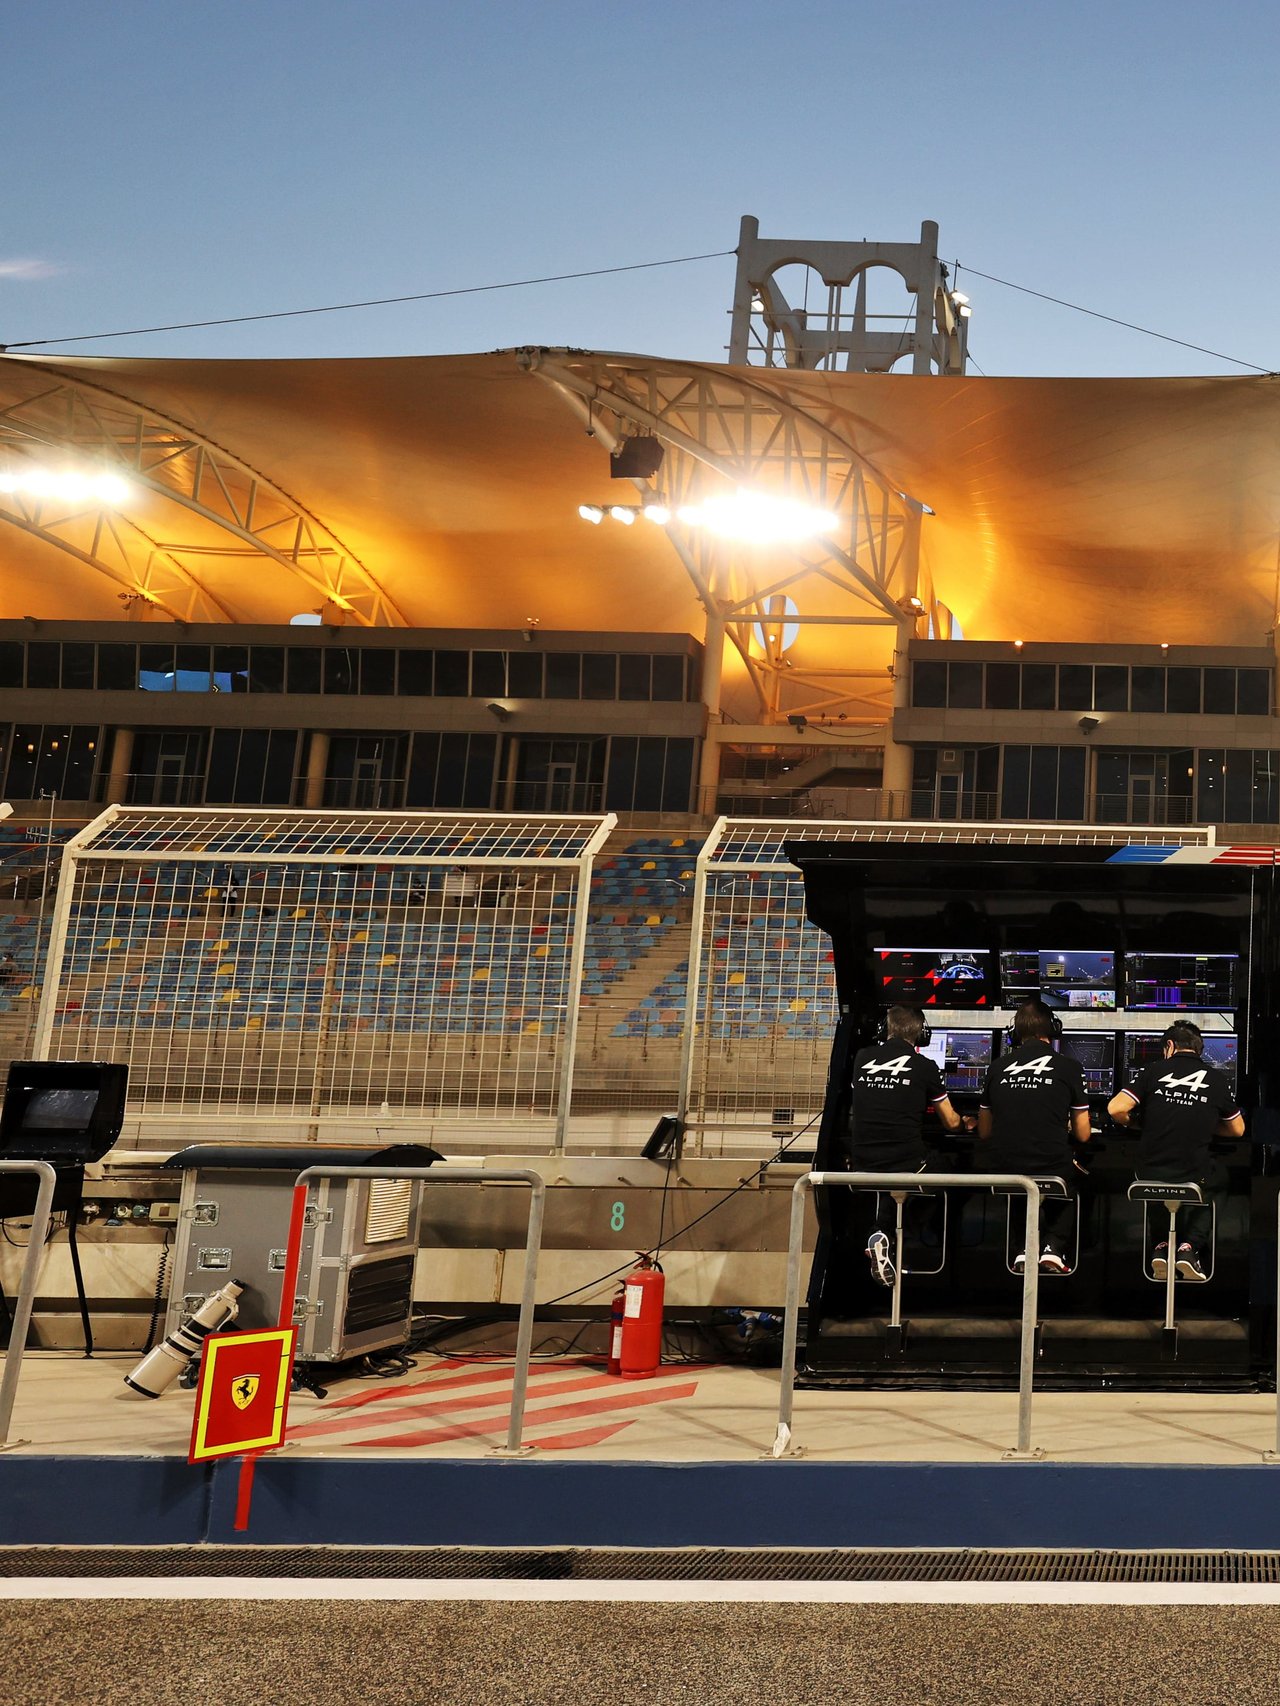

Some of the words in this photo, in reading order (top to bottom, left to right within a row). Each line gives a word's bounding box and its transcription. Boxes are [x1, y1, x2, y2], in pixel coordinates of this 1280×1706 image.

[858, 1076, 911, 1086] ALPINE
[1000, 1076, 1053, 1085] ALPINE
[1154, 1088, 1208, 1103] ALPINE
[610, 1201, 625, 1232] 8
